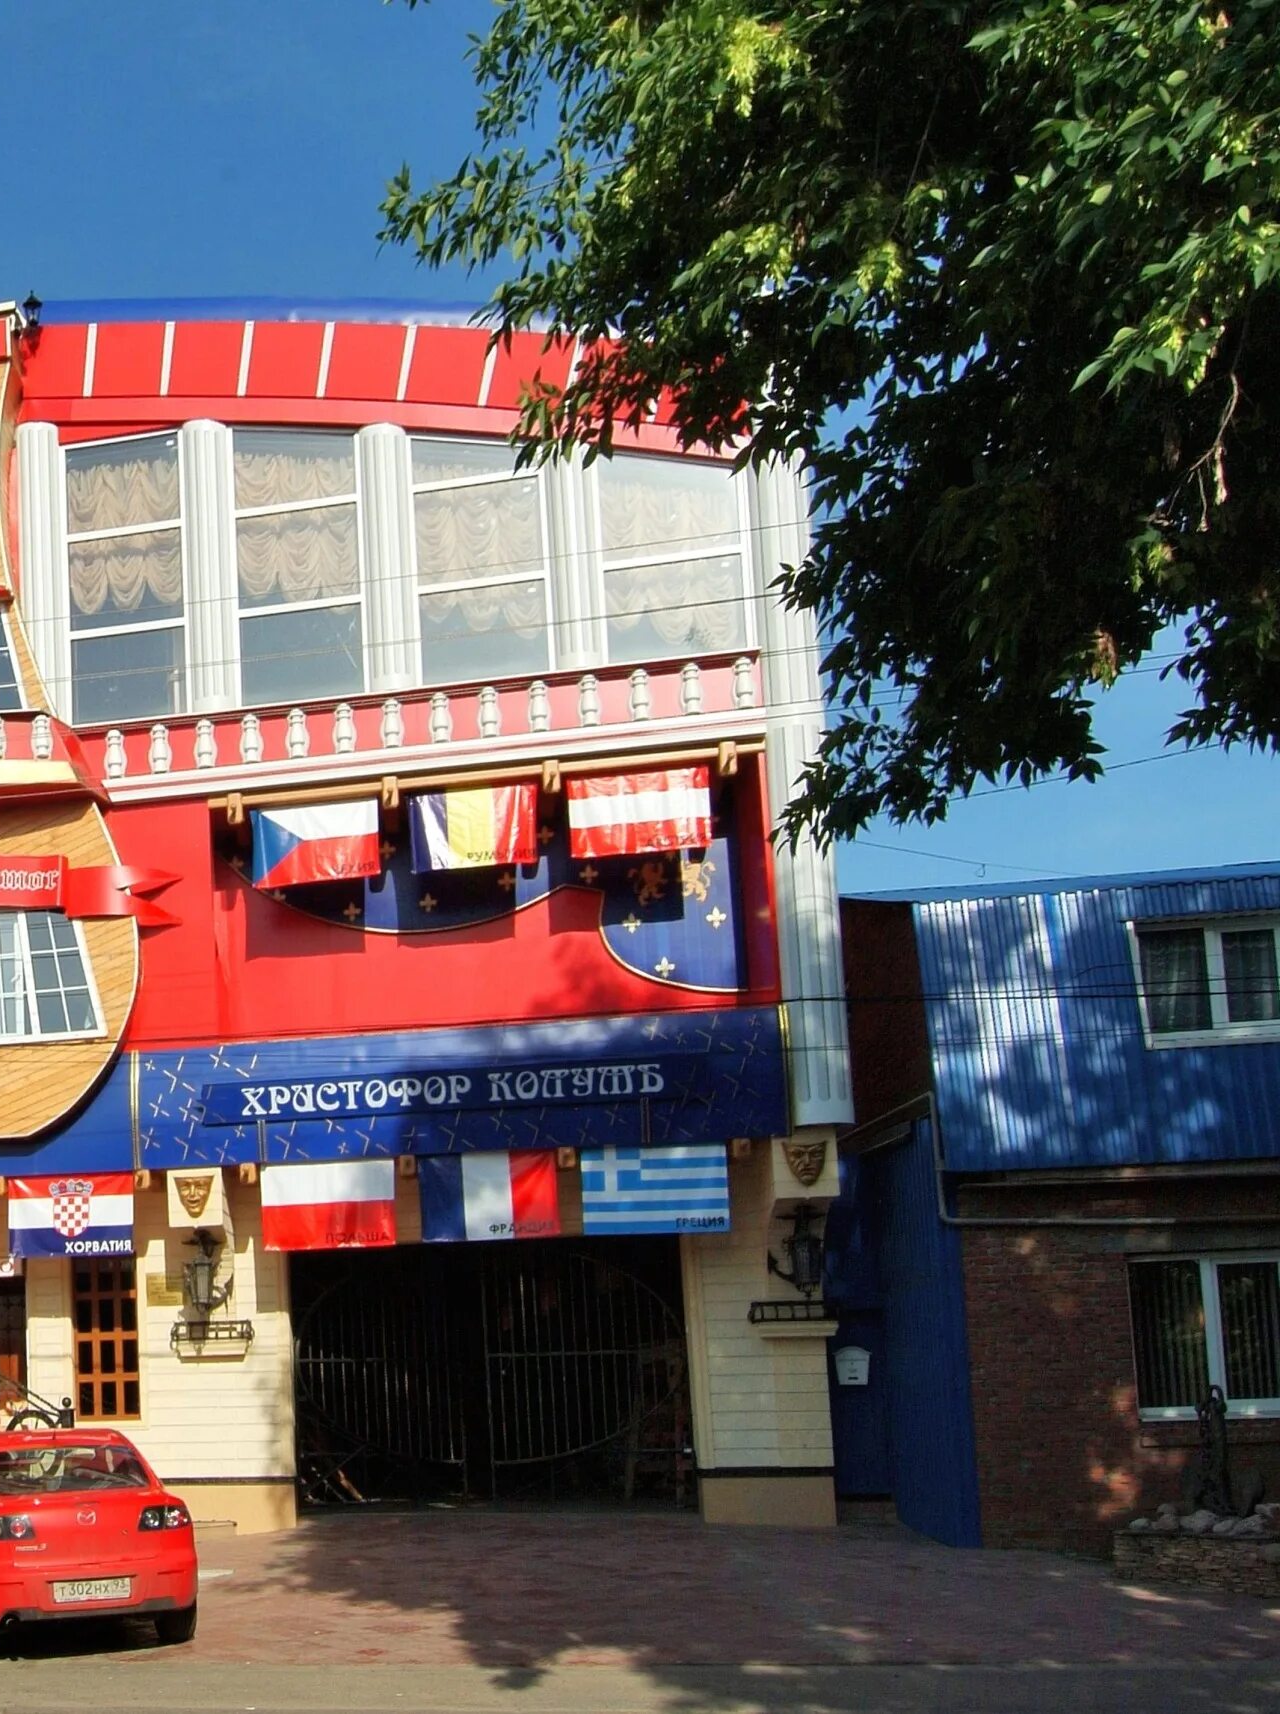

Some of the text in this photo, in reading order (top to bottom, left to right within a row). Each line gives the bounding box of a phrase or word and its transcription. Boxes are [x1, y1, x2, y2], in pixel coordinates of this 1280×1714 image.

[241, 1062, 665, 1117] ХРИСТОФОР КОЛУМБ
[675, 1215, 725, 1229] ГРЕЦИЯ
[326, 1231, 390, 1244] ПОЛЬША
[64, 1239, 132, 1254] ХОРВАТИЯ
